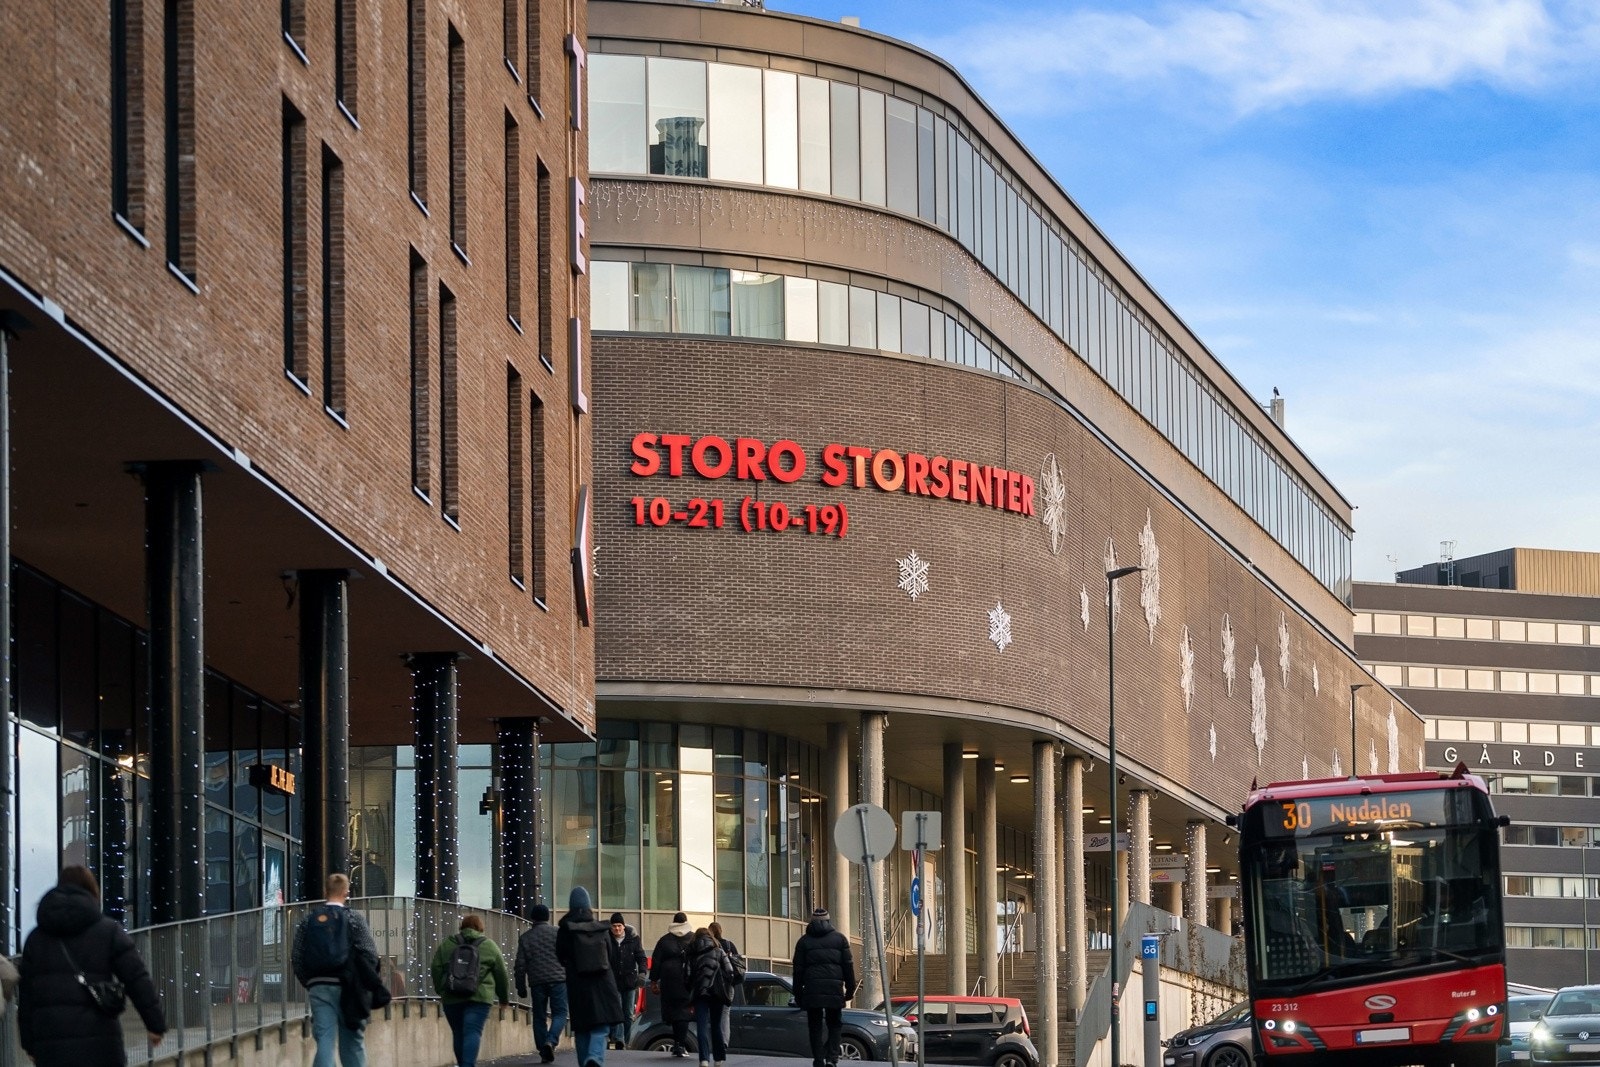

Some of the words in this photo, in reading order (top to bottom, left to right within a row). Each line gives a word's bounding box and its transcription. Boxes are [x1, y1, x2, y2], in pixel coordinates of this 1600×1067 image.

[630, 432, 807, 484] STORO
[821, 443, 1036, 517] STORSENTER
[630, 496, 725, 529] 10-21
[740, 495, 849, 539] (10-19)
[1282, 802, 1312, 830] 30
[1330, 797, 1412, 827] Nydalen
[1271, 1004, 1282, 1012] 23
[1283, 1003, 1299, 1012] 312
